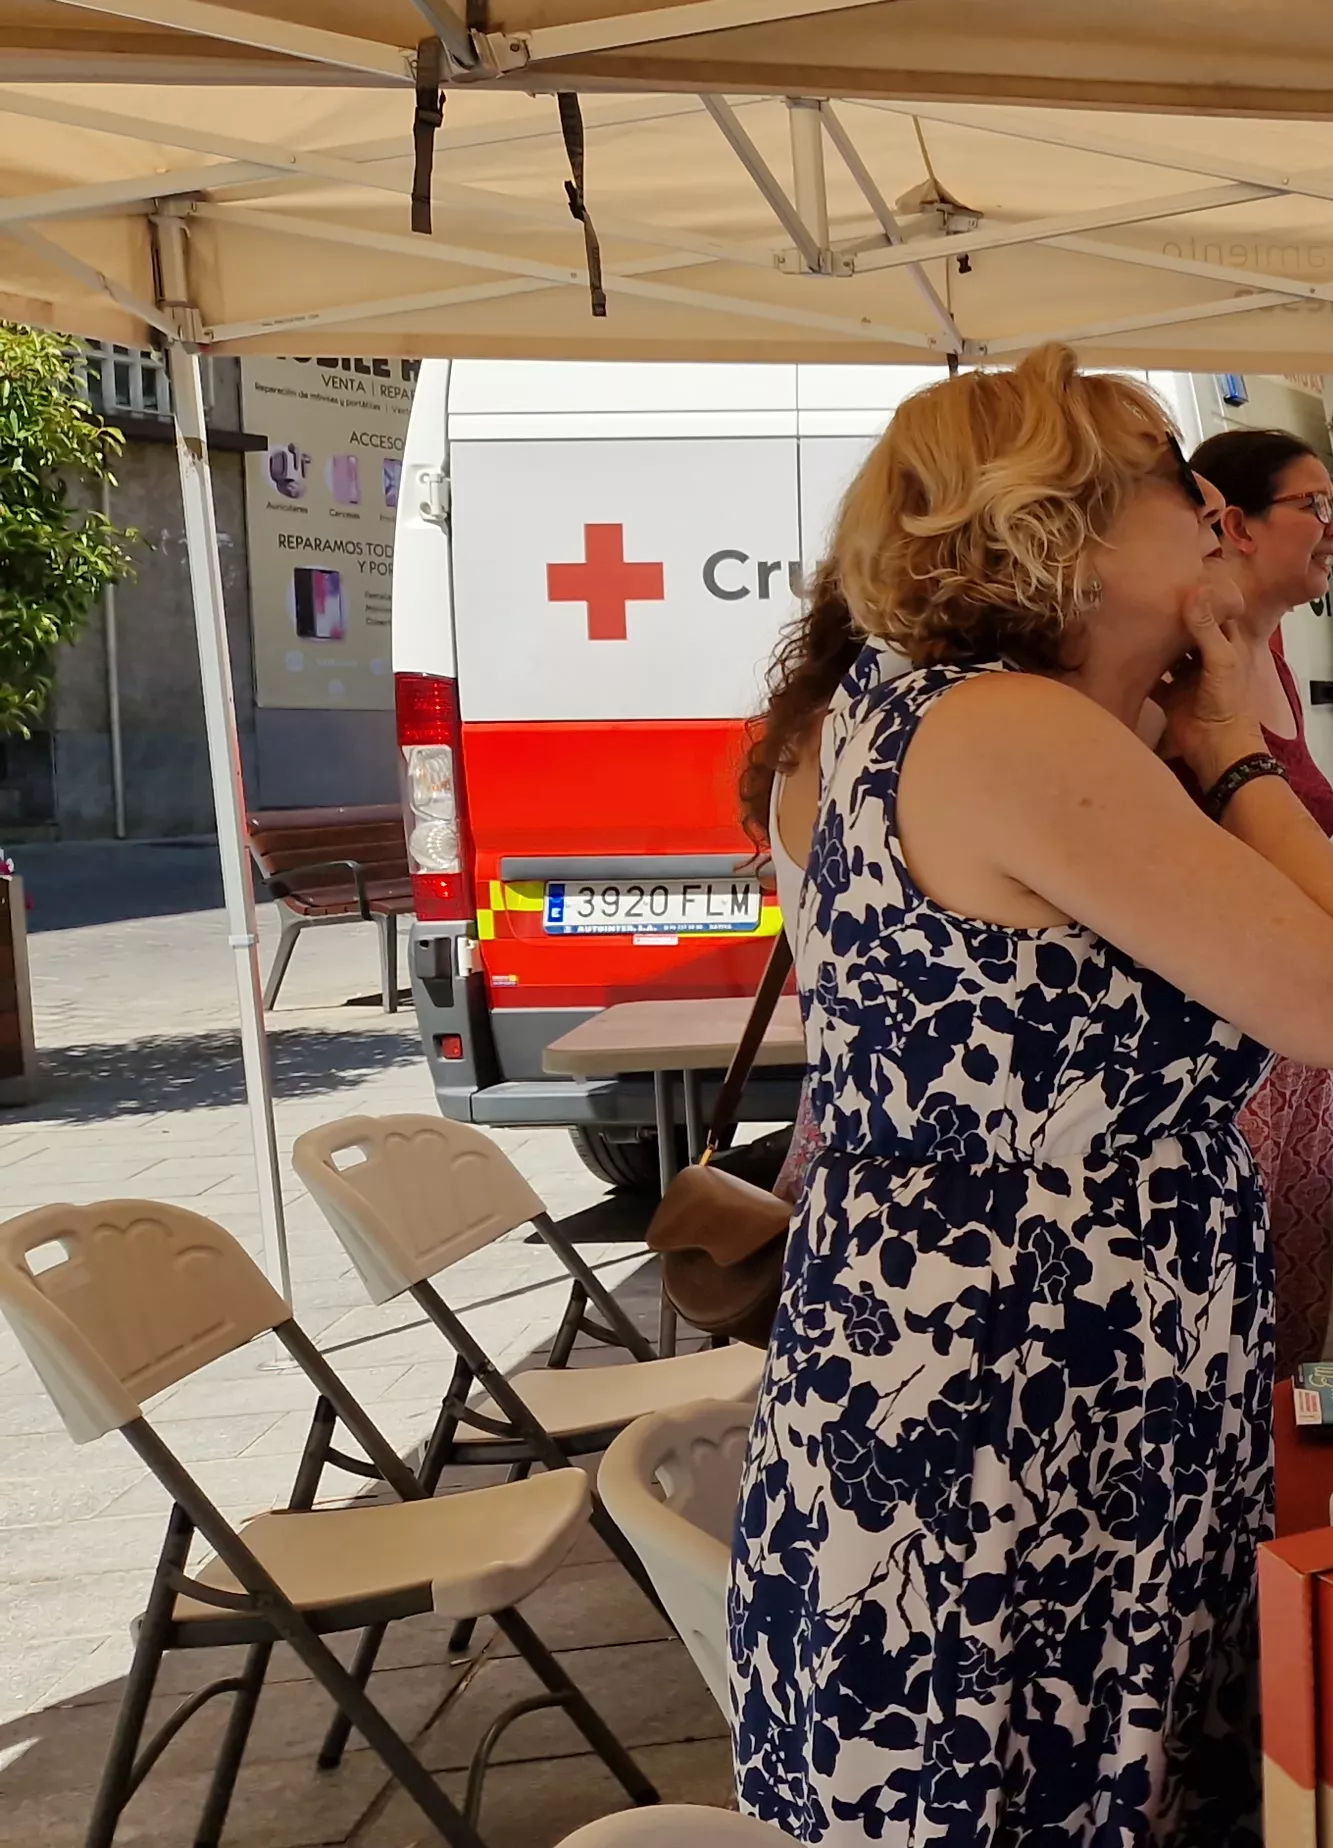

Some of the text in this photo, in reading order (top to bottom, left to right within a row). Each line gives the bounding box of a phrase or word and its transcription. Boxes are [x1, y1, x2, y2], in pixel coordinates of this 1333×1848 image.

[321, 373, 367, 394] VENTA
[278, 533, 363, 556] REPARAMOS
[357, 560, 367, 574] Y
[577, 885, 669, 918] 3920
[681, 883, 750, 917] FLM
